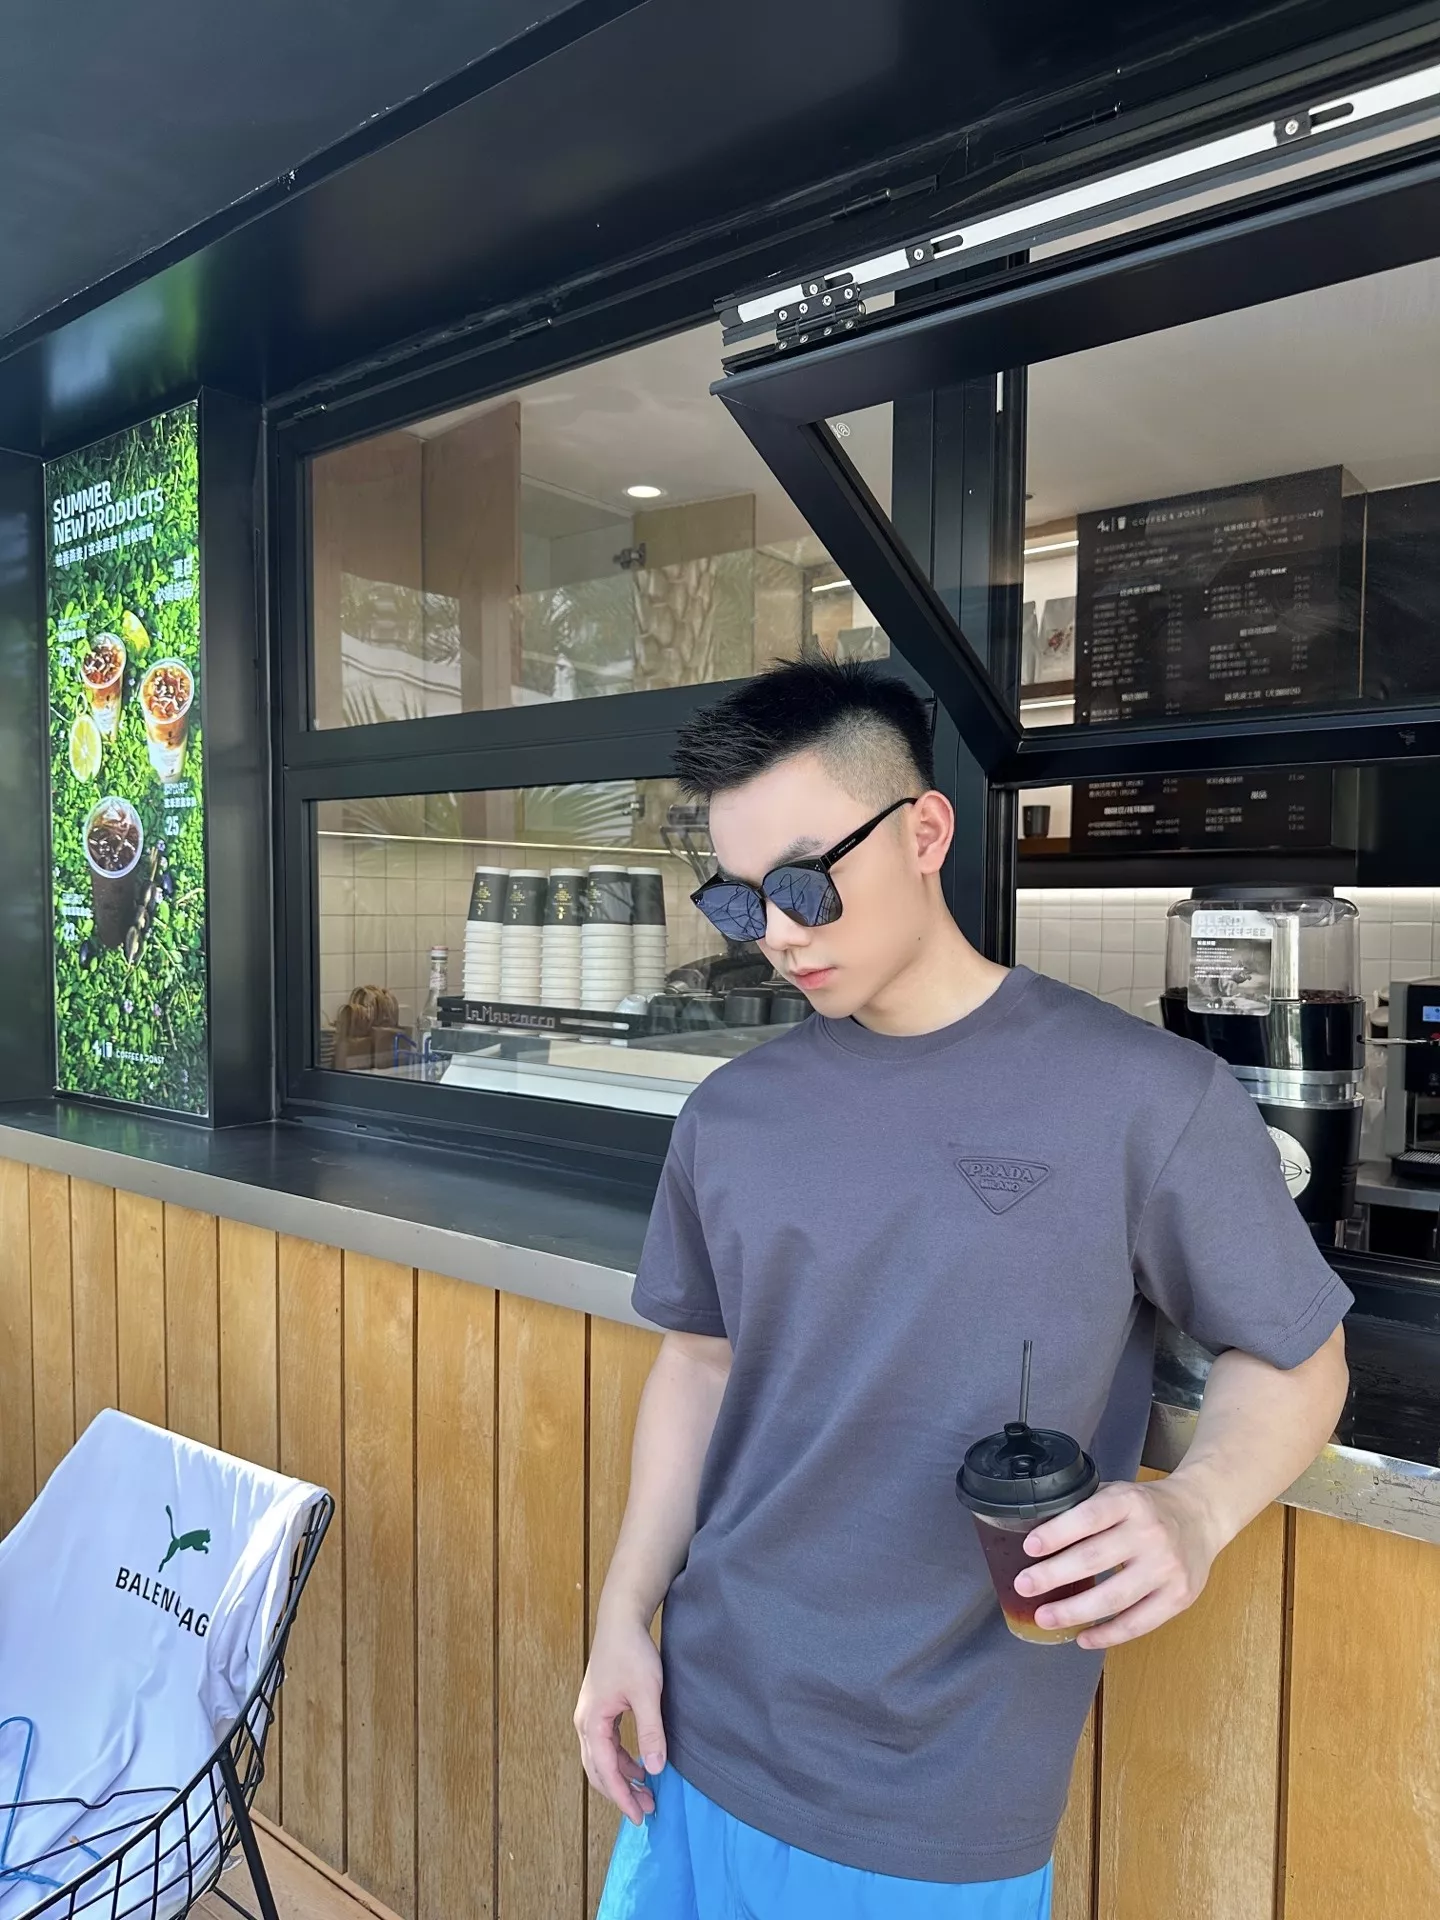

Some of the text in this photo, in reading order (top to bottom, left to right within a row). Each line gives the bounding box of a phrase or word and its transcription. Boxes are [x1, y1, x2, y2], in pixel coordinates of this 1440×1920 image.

[53, 480, 112, 523] SUMMER
[54, 486, 165, 546] NEW PRODUCTS
[968, 1163, 1035, 1183] PRADA
